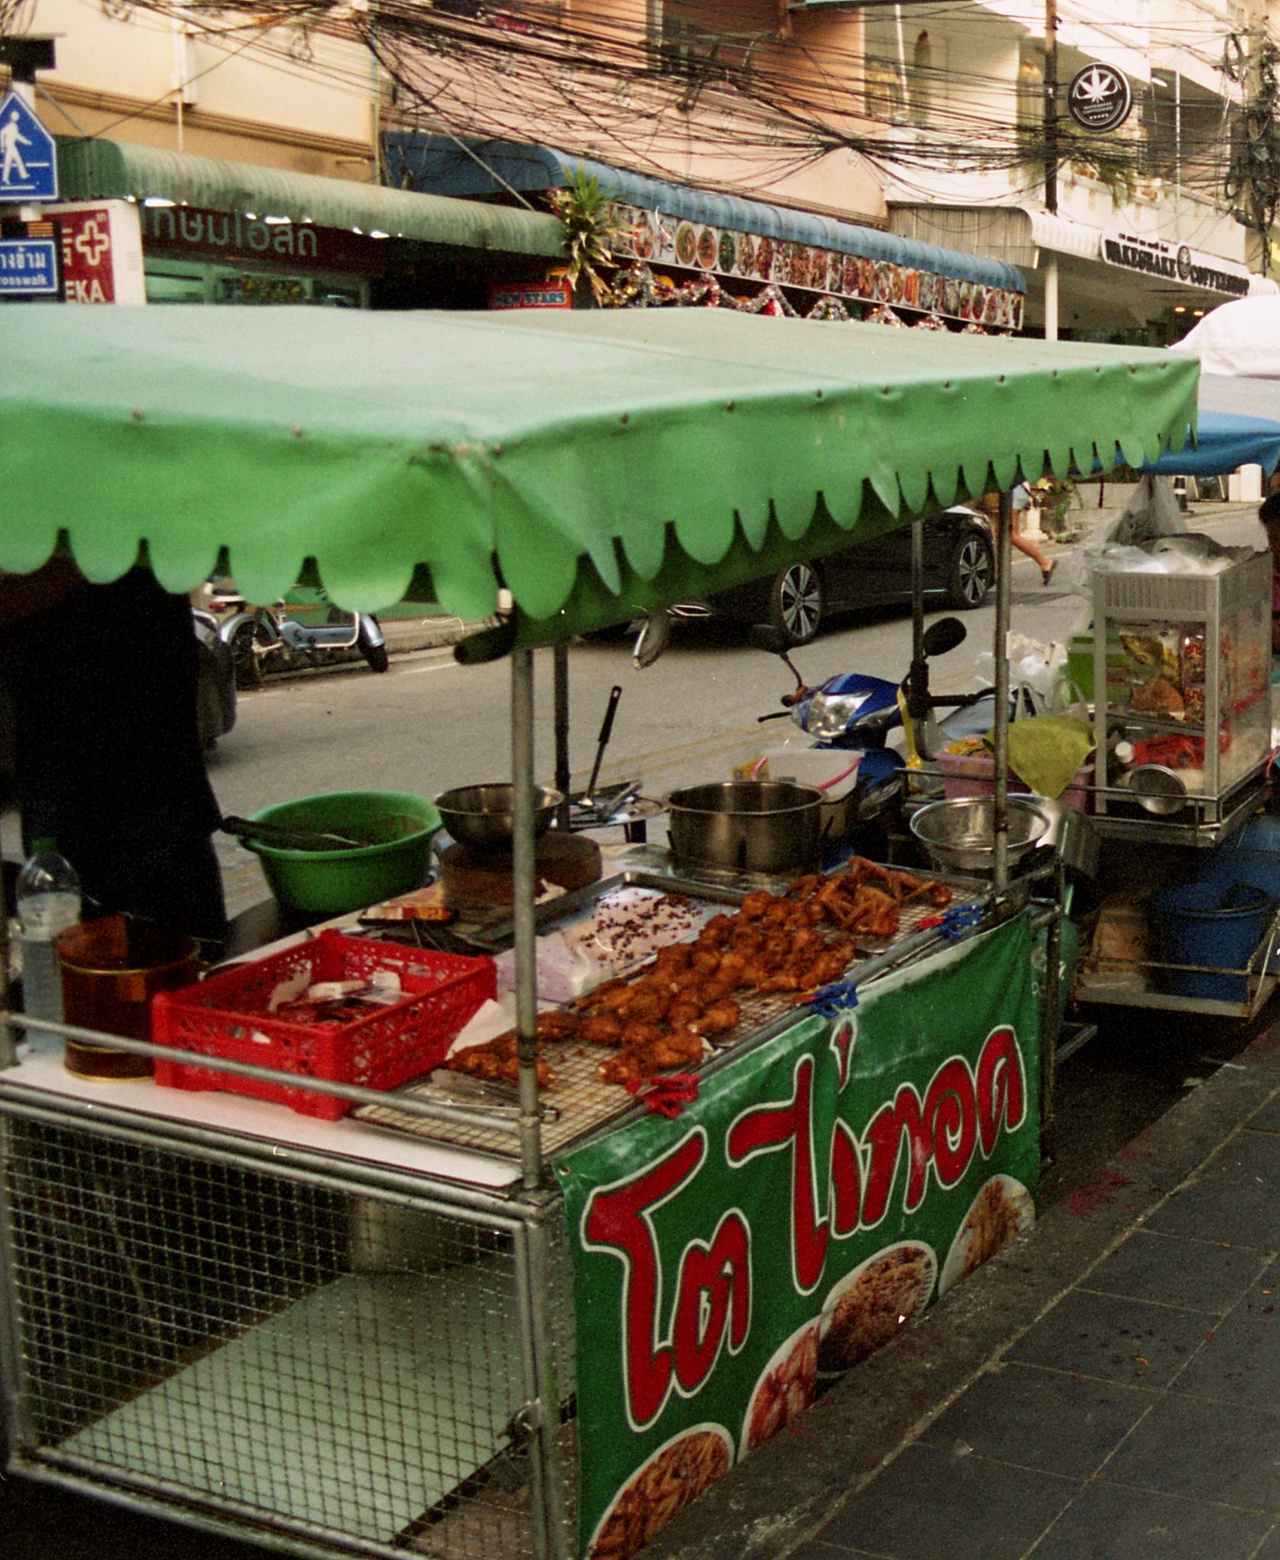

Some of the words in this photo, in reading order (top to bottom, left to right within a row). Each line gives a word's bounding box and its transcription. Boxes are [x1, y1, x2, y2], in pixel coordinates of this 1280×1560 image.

[0, 246, 46, 269] างข้าม
[524, 291, 567, 306] STARS
[582, 1125, 752, 1432] โต
[727, 1013, 1028, 1297] ไก่ทอด
